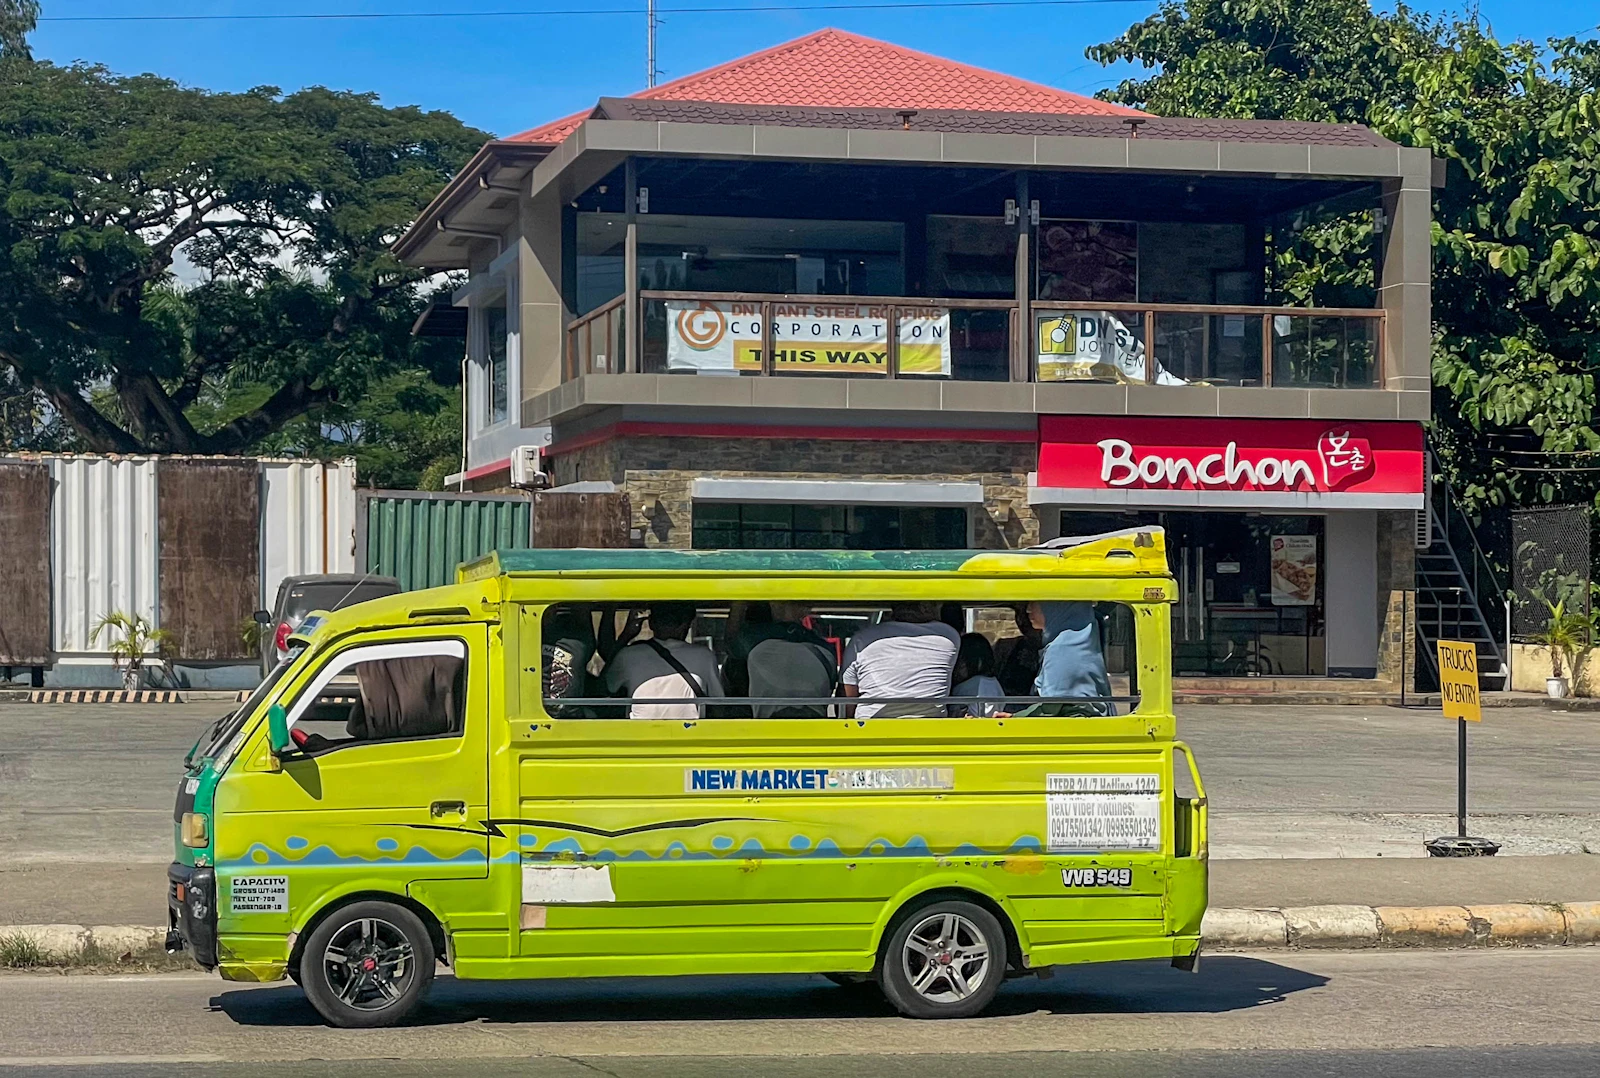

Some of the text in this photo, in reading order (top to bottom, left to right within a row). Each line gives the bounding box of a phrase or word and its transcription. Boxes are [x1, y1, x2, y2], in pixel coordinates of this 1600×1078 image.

[731, 304, 755, 317] DN
[759, 304, 806, 318] IANT
[814, 304, 864, 319] STEEL
[731, 321, 942, 338] CORPORATION
[749, 349, 888, 364] THIS WAY
[1325, 430, 1365, 471] 본촌
[1097, 439, 1315, 486] Bonchon
[1440, 646, 1475, 673] TRUCKS
[1442, 682, 1477, 705] NO ENTRY
[692, 769, 736, 790] NEW
[741, 769, 829, 790] MARKET
[233, 878, 286, 886] CAPACITY
[1061, 868, 1132, 888] VVB 549
